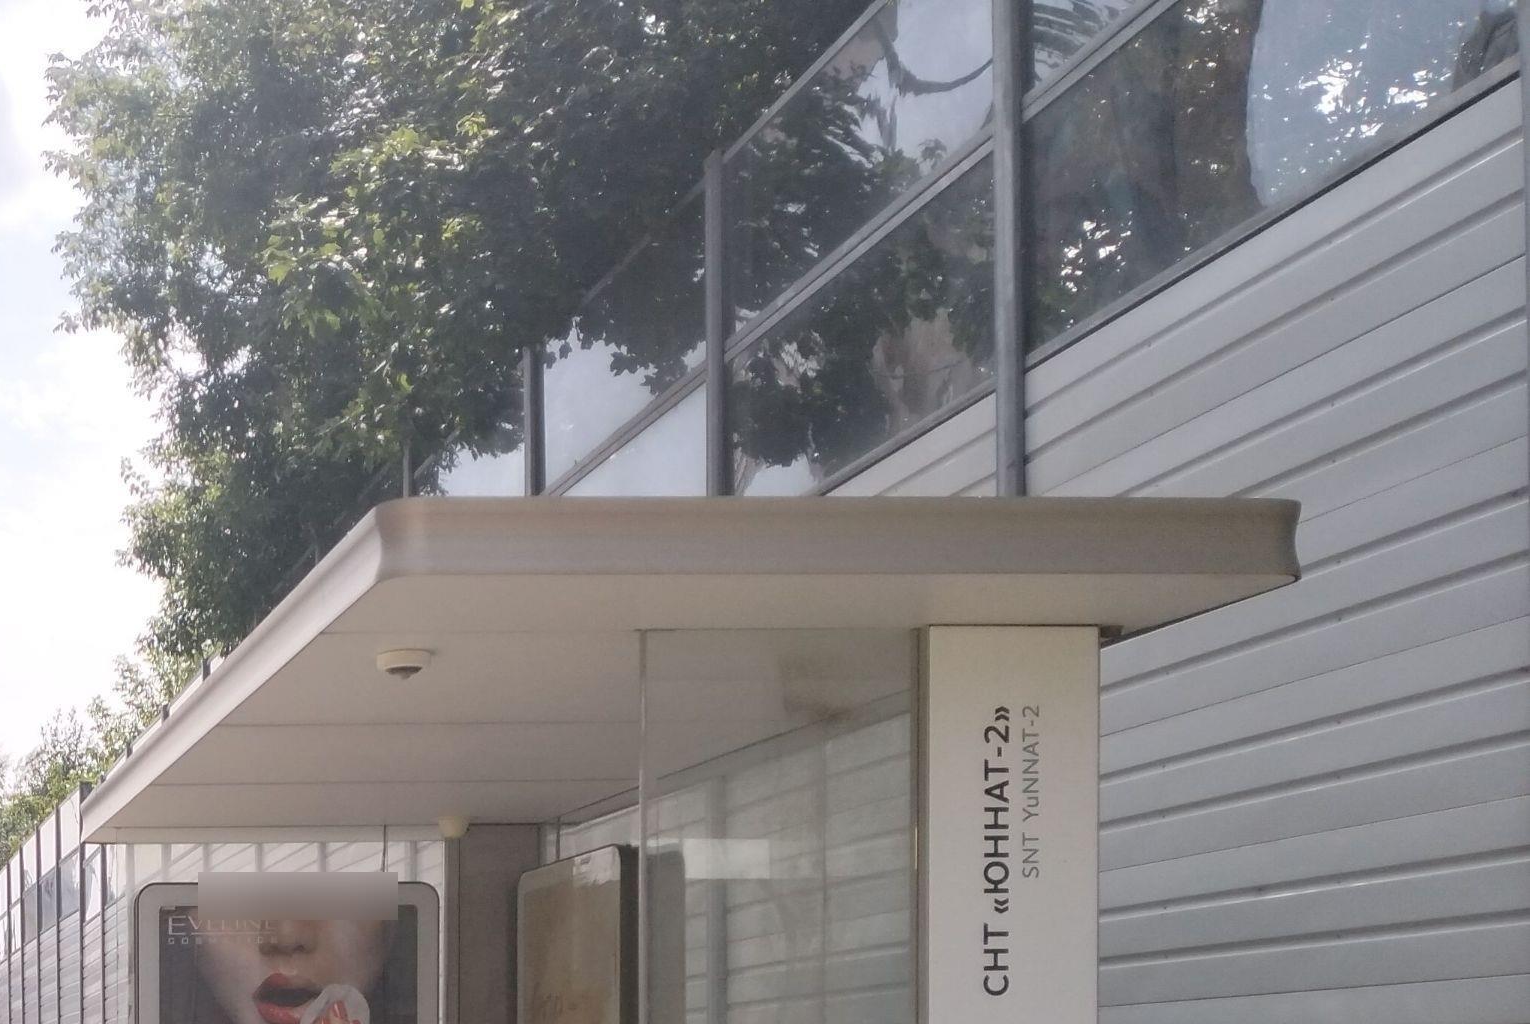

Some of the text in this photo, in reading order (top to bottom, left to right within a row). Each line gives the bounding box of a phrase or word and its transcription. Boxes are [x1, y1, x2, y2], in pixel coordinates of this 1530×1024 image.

[983, 705, 1010, 996] СНТ «ЮННАТ-2»
[1022, 704, 1040, 878] SNT YuNNAT-2
